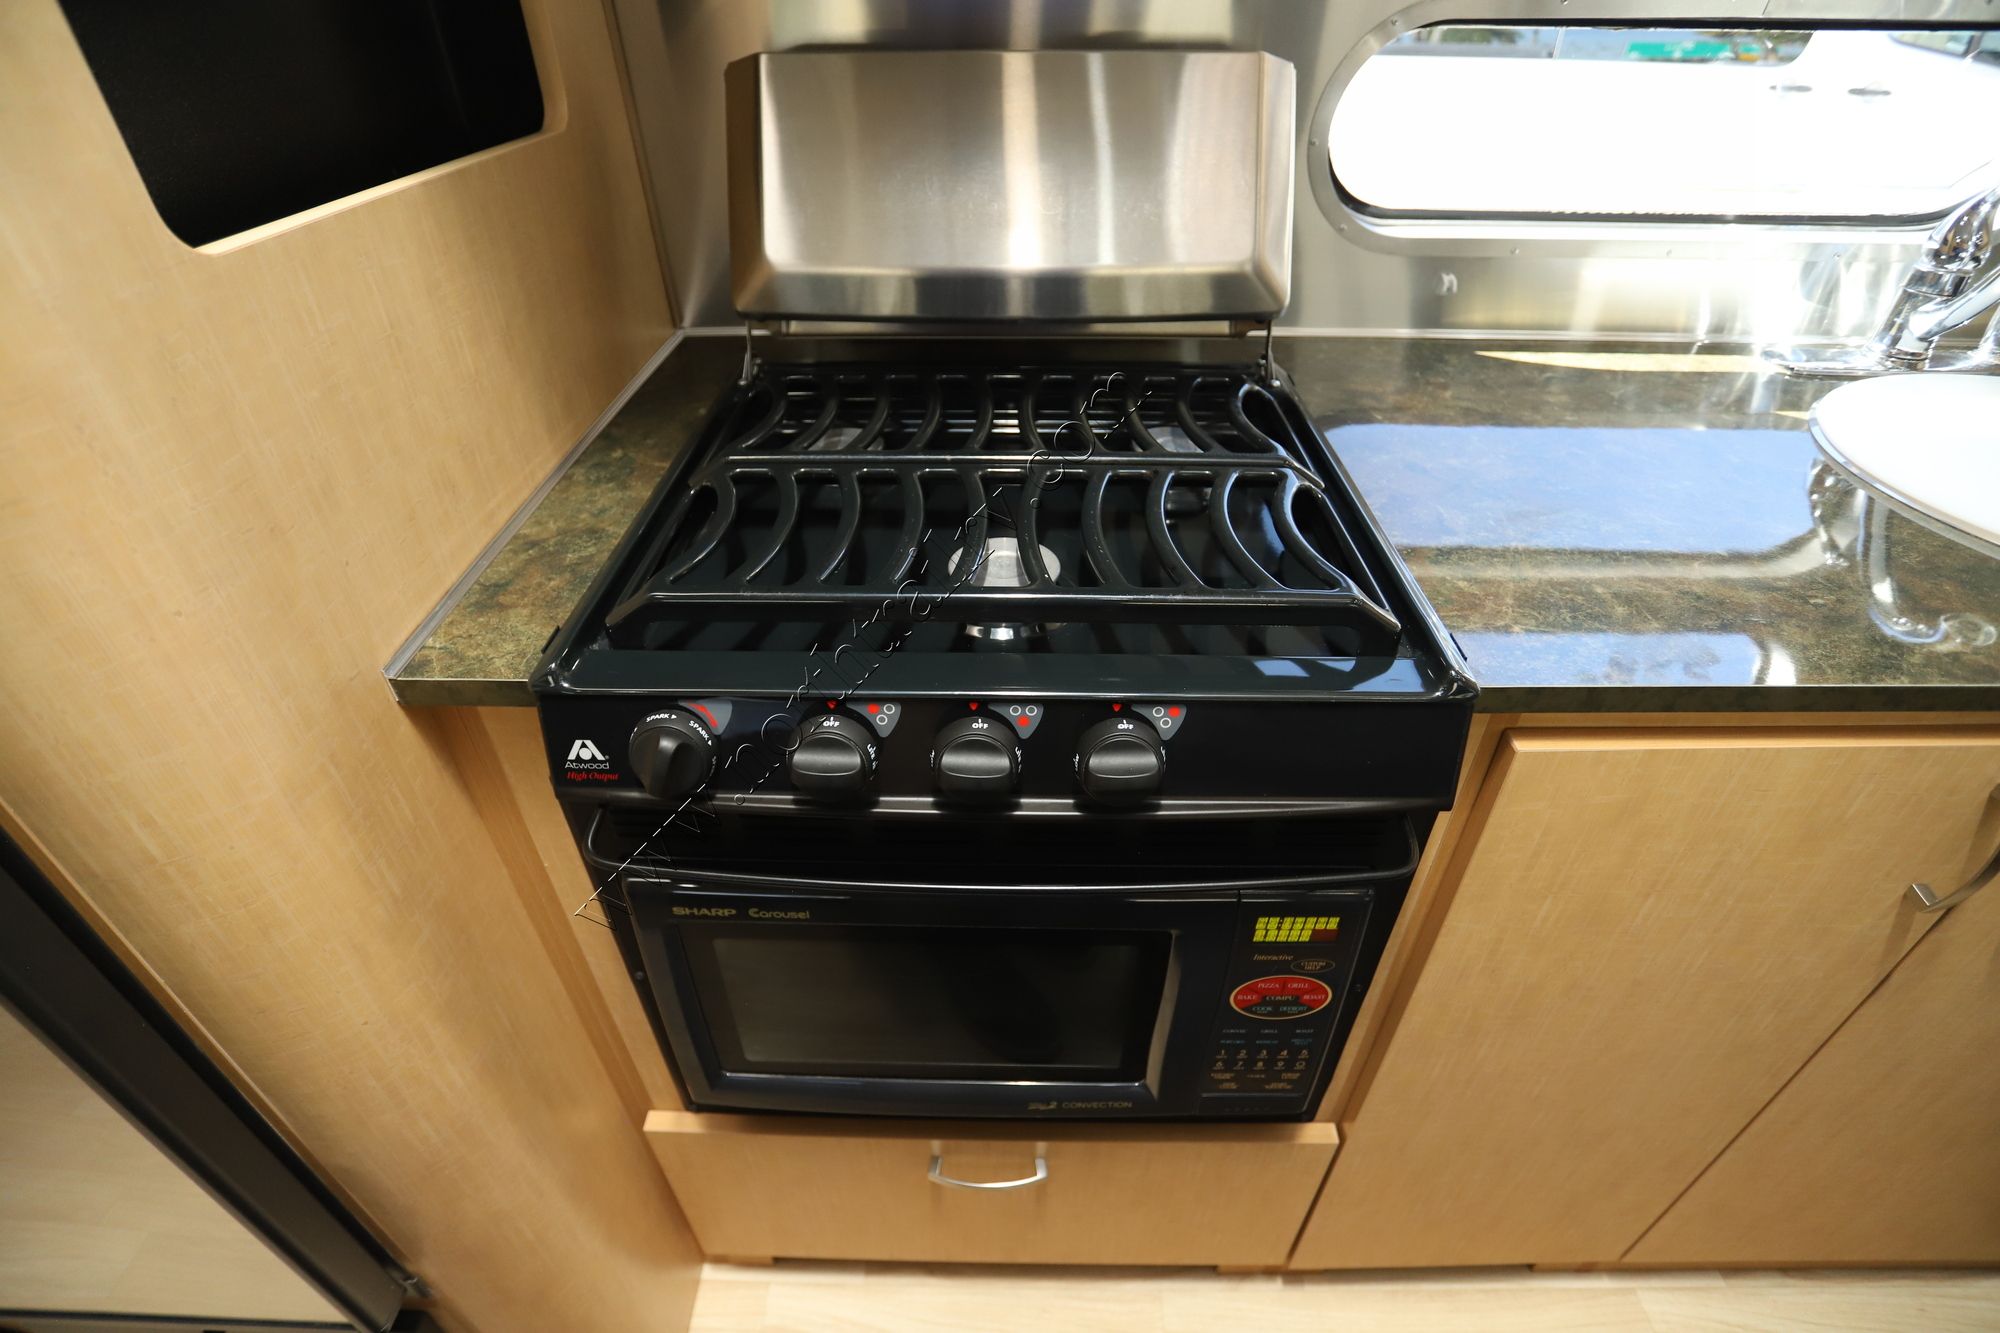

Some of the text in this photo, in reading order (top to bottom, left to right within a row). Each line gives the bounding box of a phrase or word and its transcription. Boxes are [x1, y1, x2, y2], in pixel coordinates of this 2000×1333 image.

[646, 713, 670, 723] SPARK
[823, 720, 840, 728] OFF
[688, 720, 710, 741] SPARK
[565, 761, 610, 770] Atwood
[566, 771, 620, 783] High Output
[672, 906, 810, 919] SHARP Carousel
[1252, 953, 1294, 961] Interactive
[1062, 1101, 1133, 1109] CONVECTION
